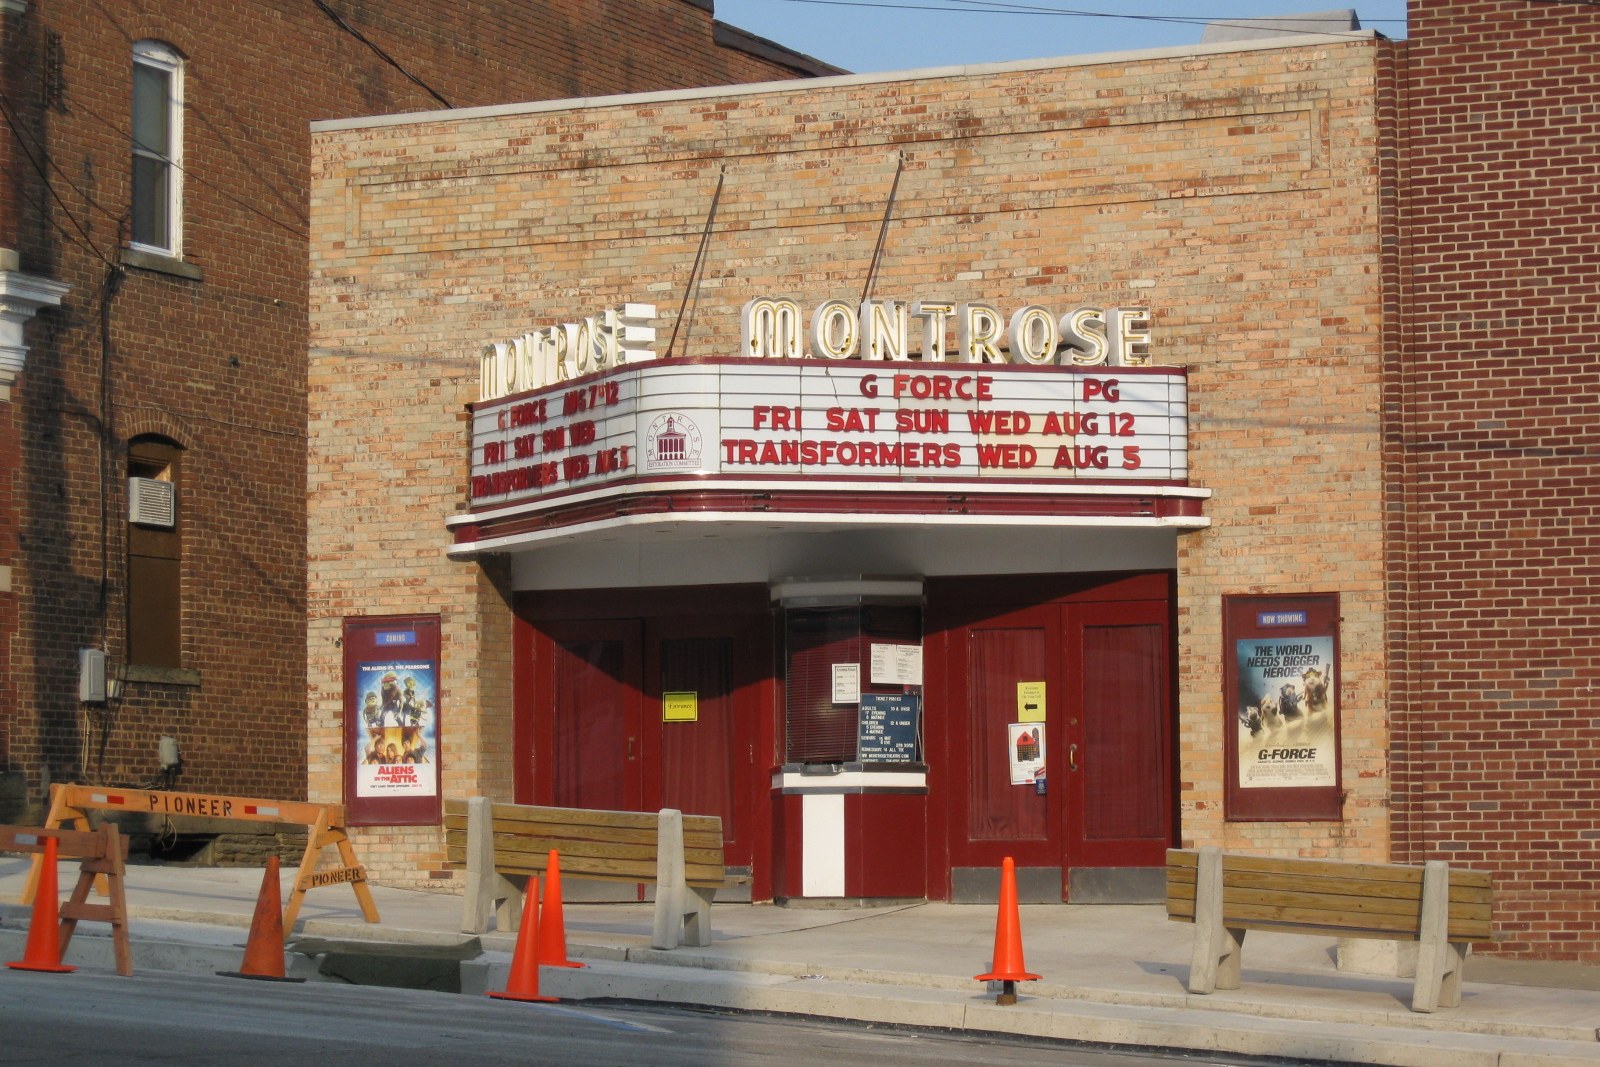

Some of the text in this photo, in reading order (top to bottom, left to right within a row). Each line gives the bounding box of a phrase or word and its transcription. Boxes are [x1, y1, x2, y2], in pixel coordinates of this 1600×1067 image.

[741, 296, 1152, 367] MONTROSE
[480, 303, 656, 402] MONTROSE
[860, 374, 1120, 403] G FORCE PG
[510, 398, 547, 429] FORCE
[753, 405, 1136, 437] FRI SAT SUN WED AUG 12
[484, 440, 506, 466] FRI
[514, 433, 536, 460] SAT
[542, 425, 565, 453] SUN
[648, 415, 699, 456] MONTROSE
[721, 439, 1142, 470] TRANSFORMERS WED AUG 5
[1262, 613, 1303, 624] NOW SHOWING
[1247, 655, 1320, 667] NEEDS BIGGER
[1254, 644, 1312, 657] THE WORLD
[1258, 748, 1317, 760] G-FORCE
[378, 766, 414, 775] ALIENS
[390, 774, 418, 783] ATTIC
[150, 795, 232, 817] PIONEER
[312, 868, 361, 886] PIONEER
